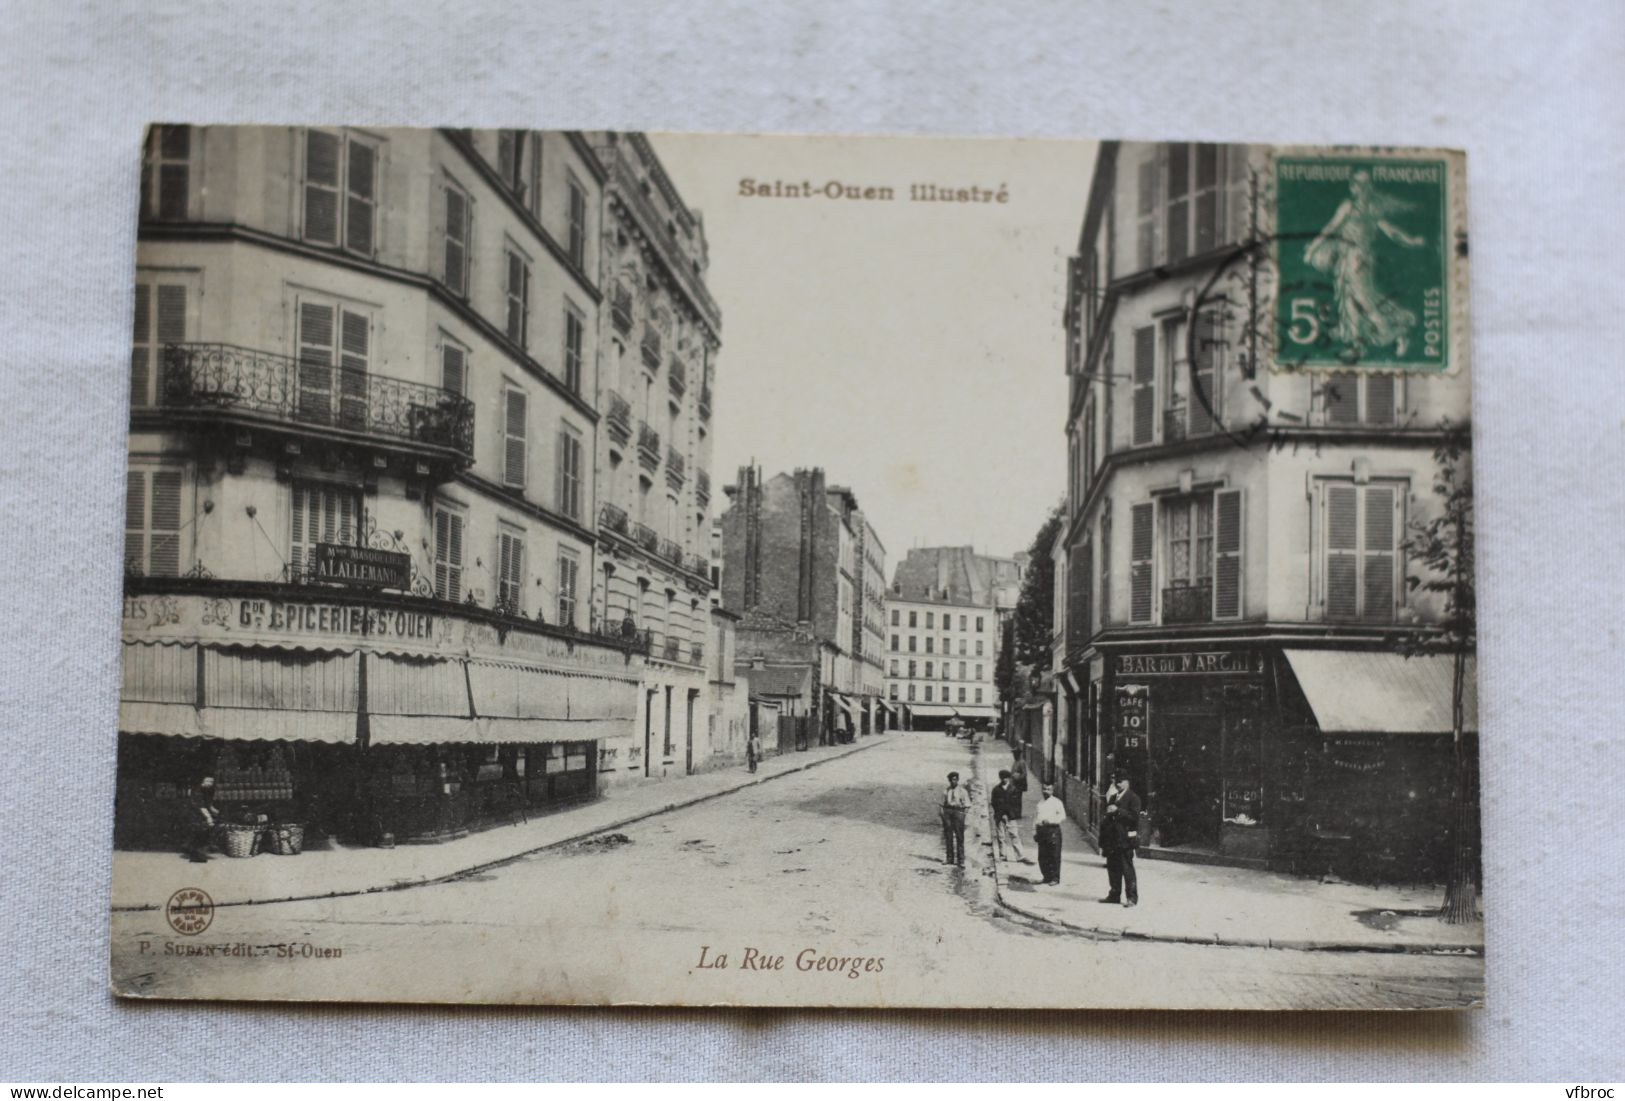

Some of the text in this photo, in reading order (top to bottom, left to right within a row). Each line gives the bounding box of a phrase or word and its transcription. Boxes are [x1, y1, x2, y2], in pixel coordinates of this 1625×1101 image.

[738, 178, 895, 201] Saint-Ouen
[1423, 287, 1441, 356] POSTES
[1122, 655, 1156, 673] BAR
[1124, 737, 1139, 748] 15
[139, 941, 156, 955] P.
[696, 946, 885, 979] La Rue Georges
